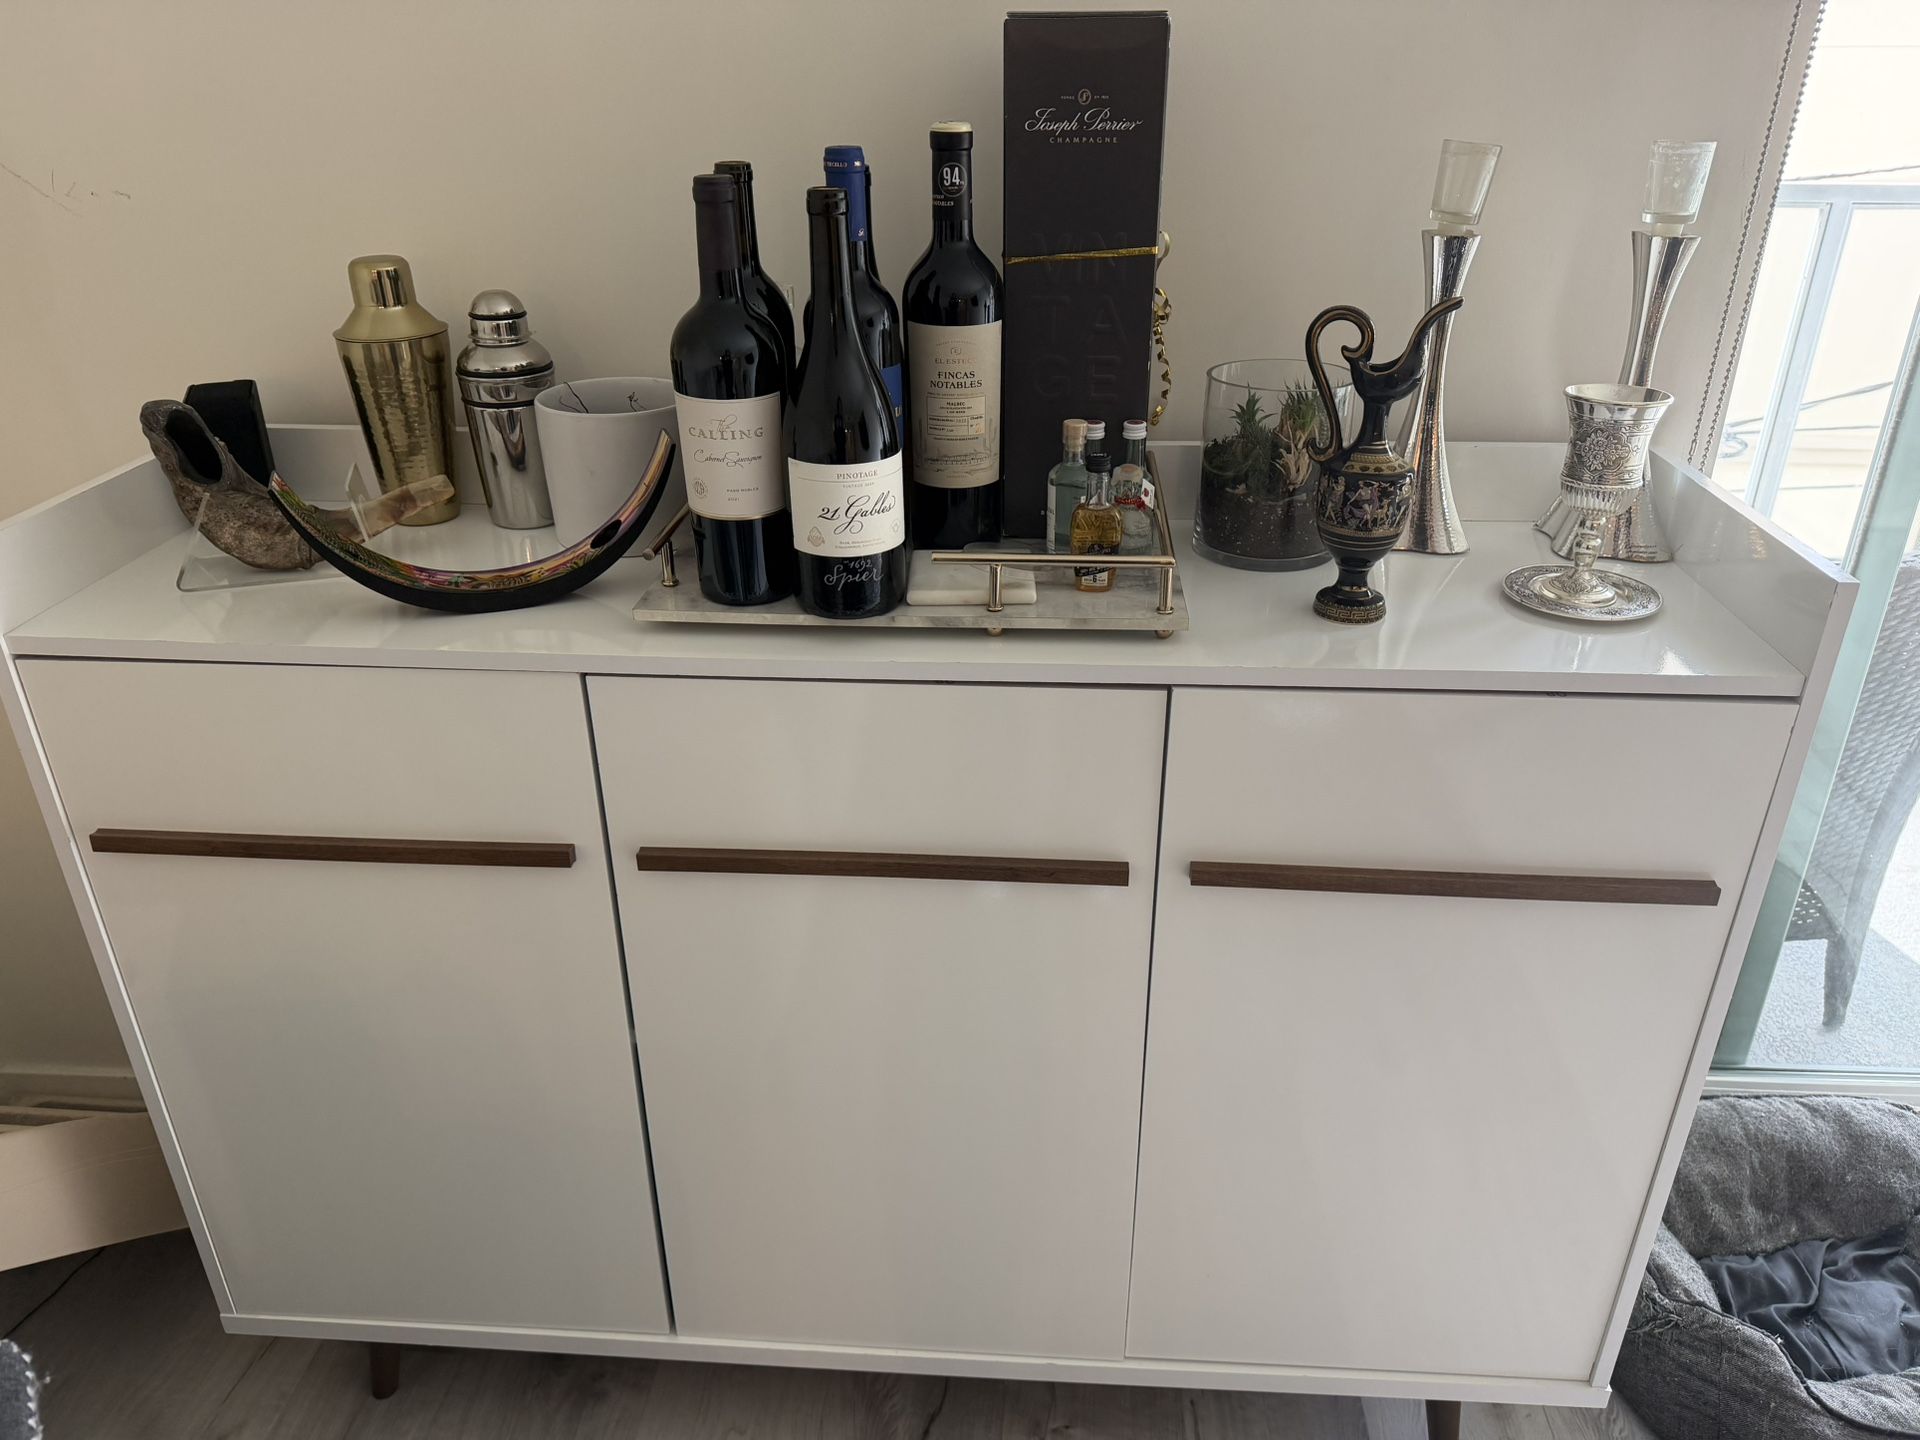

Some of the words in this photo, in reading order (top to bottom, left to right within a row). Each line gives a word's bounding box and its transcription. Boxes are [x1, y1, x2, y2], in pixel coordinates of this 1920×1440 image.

[1024, 107, 1081, 136] Joseph
[1083, 107, 1144, 132] Perrier
[1049, 136, 1119, 144] CHAMPAGNE
[942, 166, 961, 186] 94
[937, 371, 976, 380] FINCAS
[929, 380, 983, 390] NOTABLES
[711, 414, 738, 433] The
[688, 426, 764, 441] CALLING
[836, 469, 879, 480] PINOTAGE
[816, 506, 842, 521] 21
[833, 490, 896, 535] Gables
[823, 564, 886, 592] Spier
